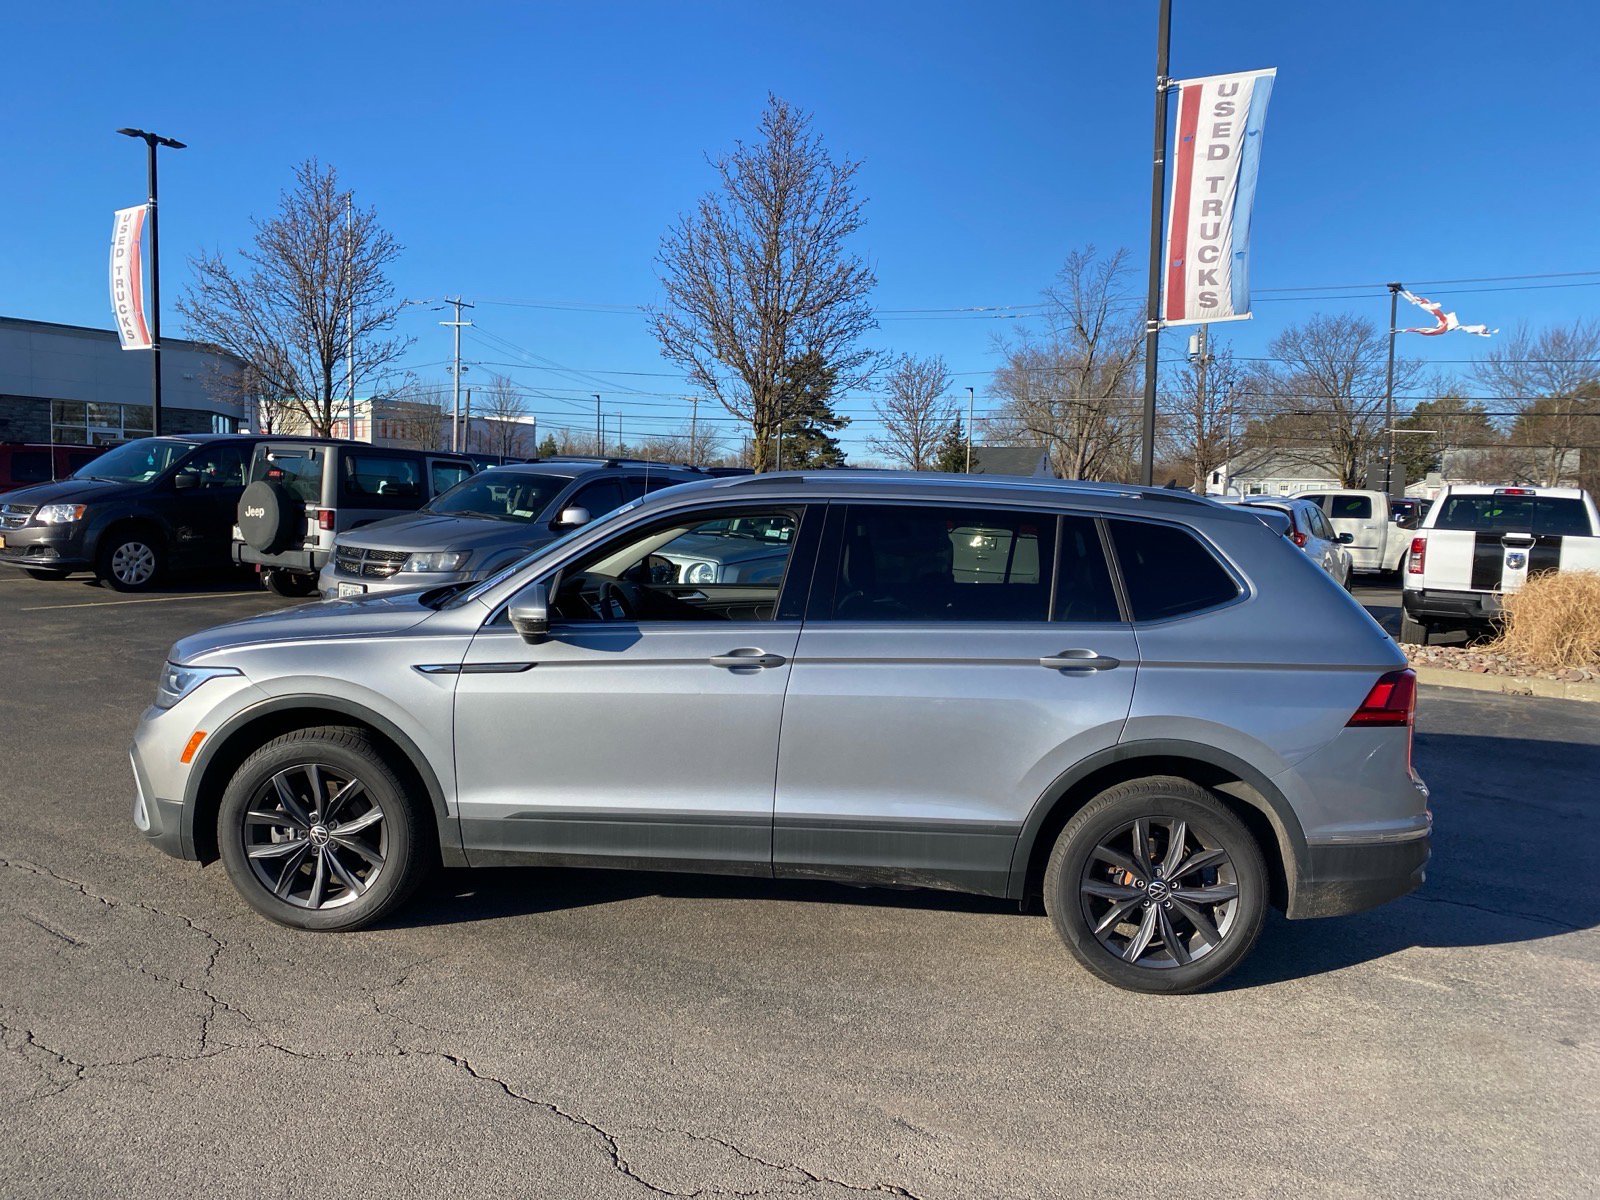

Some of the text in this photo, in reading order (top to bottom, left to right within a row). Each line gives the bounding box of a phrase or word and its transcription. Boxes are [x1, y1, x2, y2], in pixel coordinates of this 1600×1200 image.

[1197, 82, 1239, 309] USED TRUCKS
[115, 213, 135, 340] USED TRUCKS
[244, 505, 265, 519] Jeep
